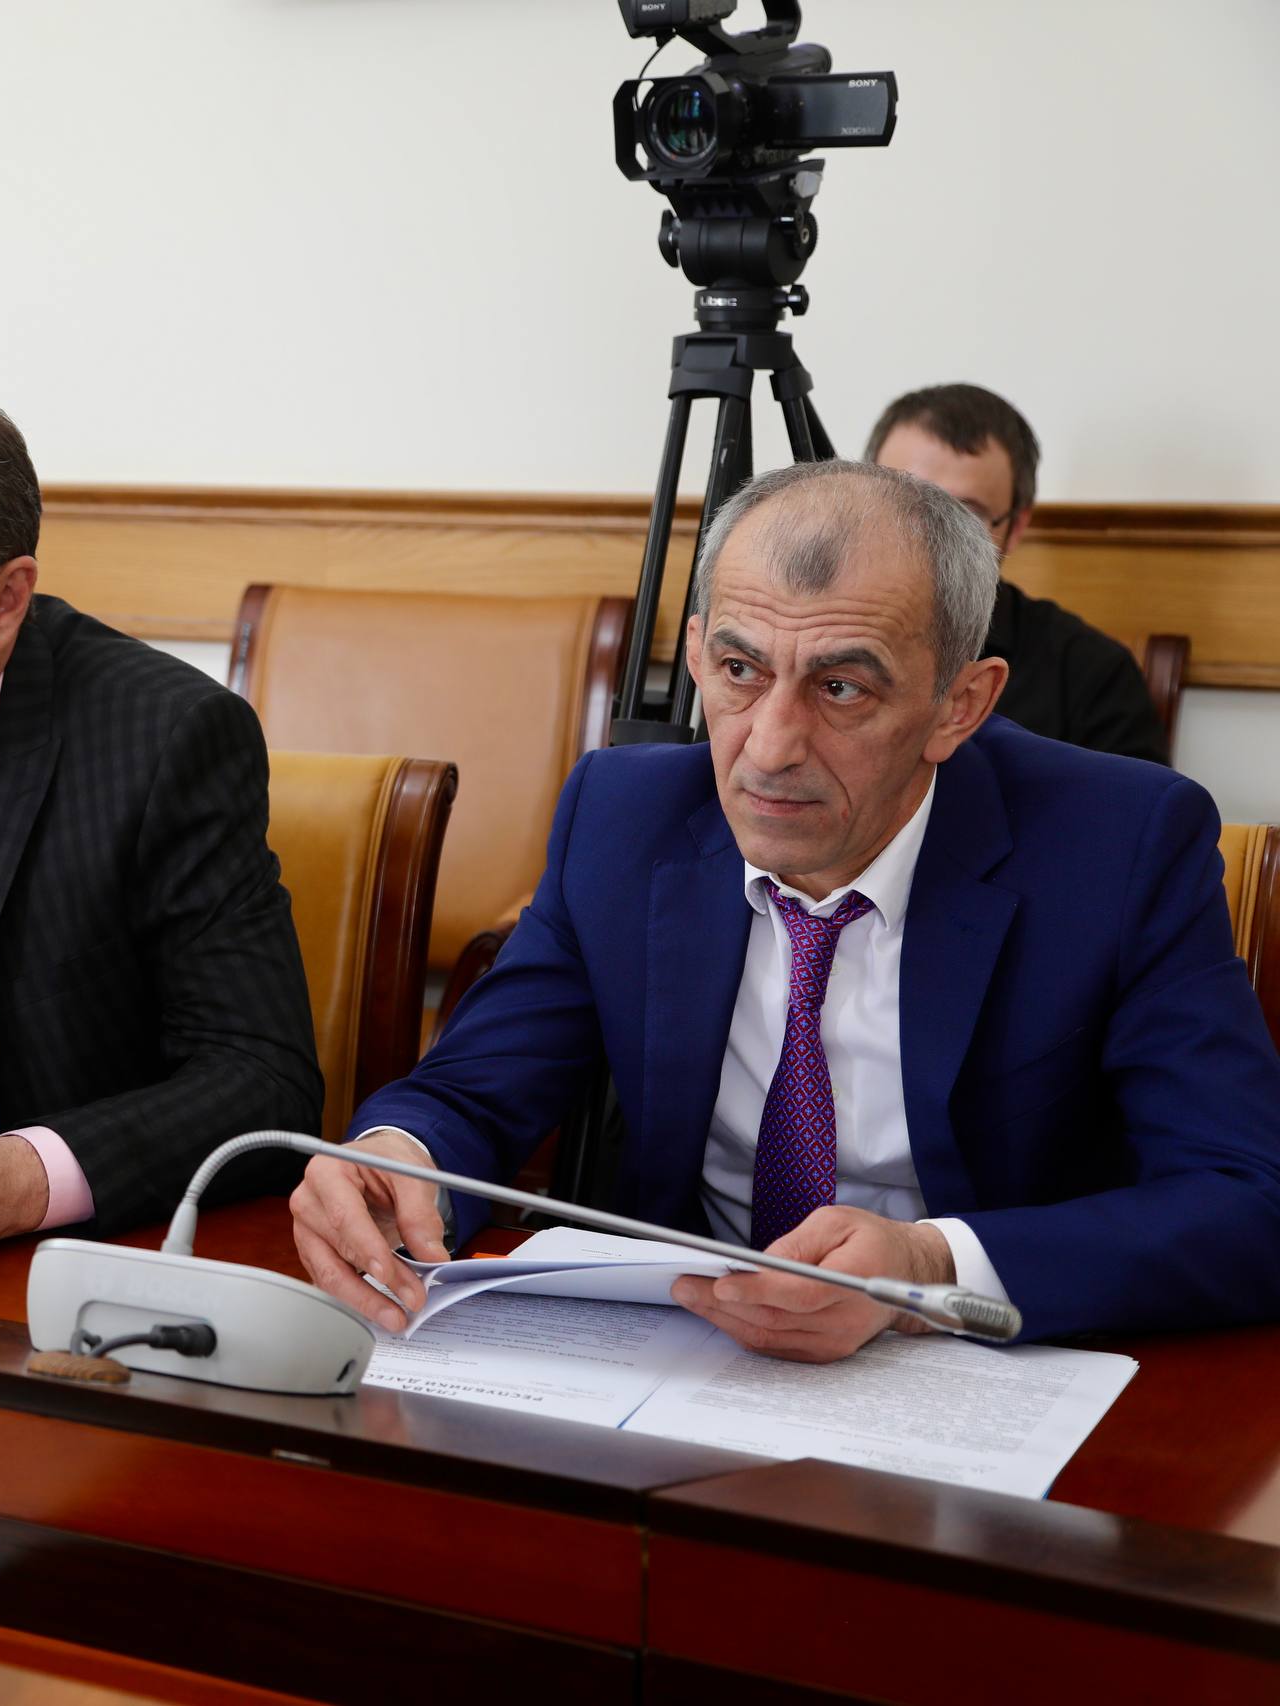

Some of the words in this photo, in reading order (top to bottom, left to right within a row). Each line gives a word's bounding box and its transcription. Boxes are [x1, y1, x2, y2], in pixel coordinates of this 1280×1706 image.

[641, 3, 666, 11] SONY
[848, 79, 878, 88] SONY
[369, 1373, 418, 1385] ДАГЕС
[425, 1380, 544, 1402] РЕСПУБЛИКИ
